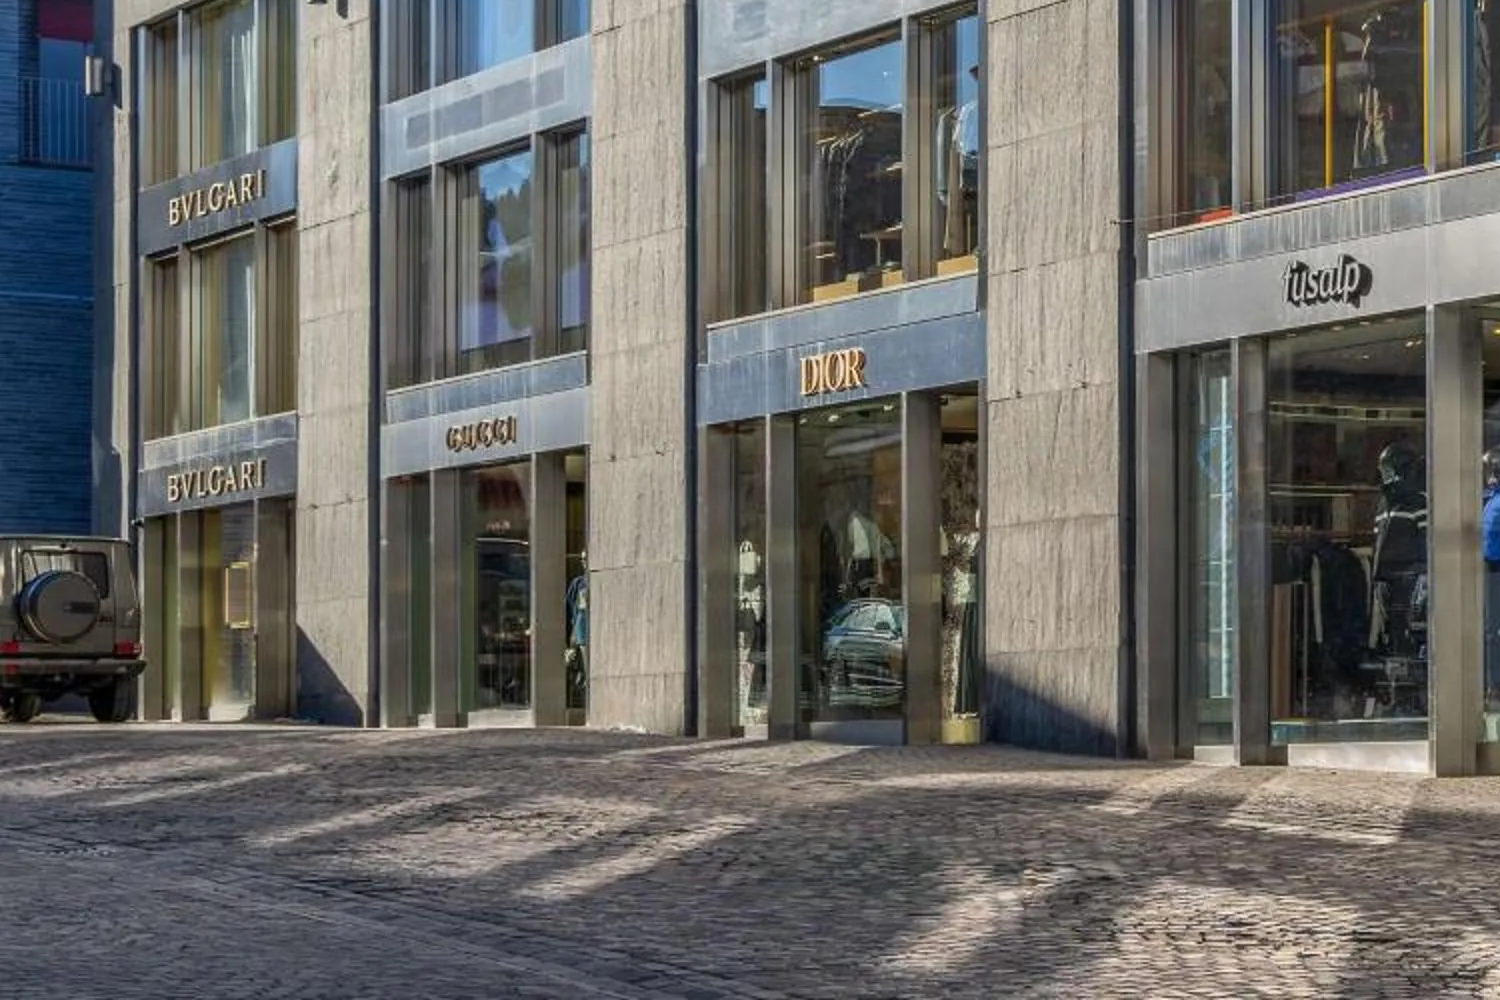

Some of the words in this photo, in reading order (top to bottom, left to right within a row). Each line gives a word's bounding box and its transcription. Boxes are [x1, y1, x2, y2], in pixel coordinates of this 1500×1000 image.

[169, 168, 267, 226] BVLGARI
[800, 348, 866, 396] DIOR
[446, 415, 517, 453] GUCCI
[167, 457, 267, 503] BVLGARI
